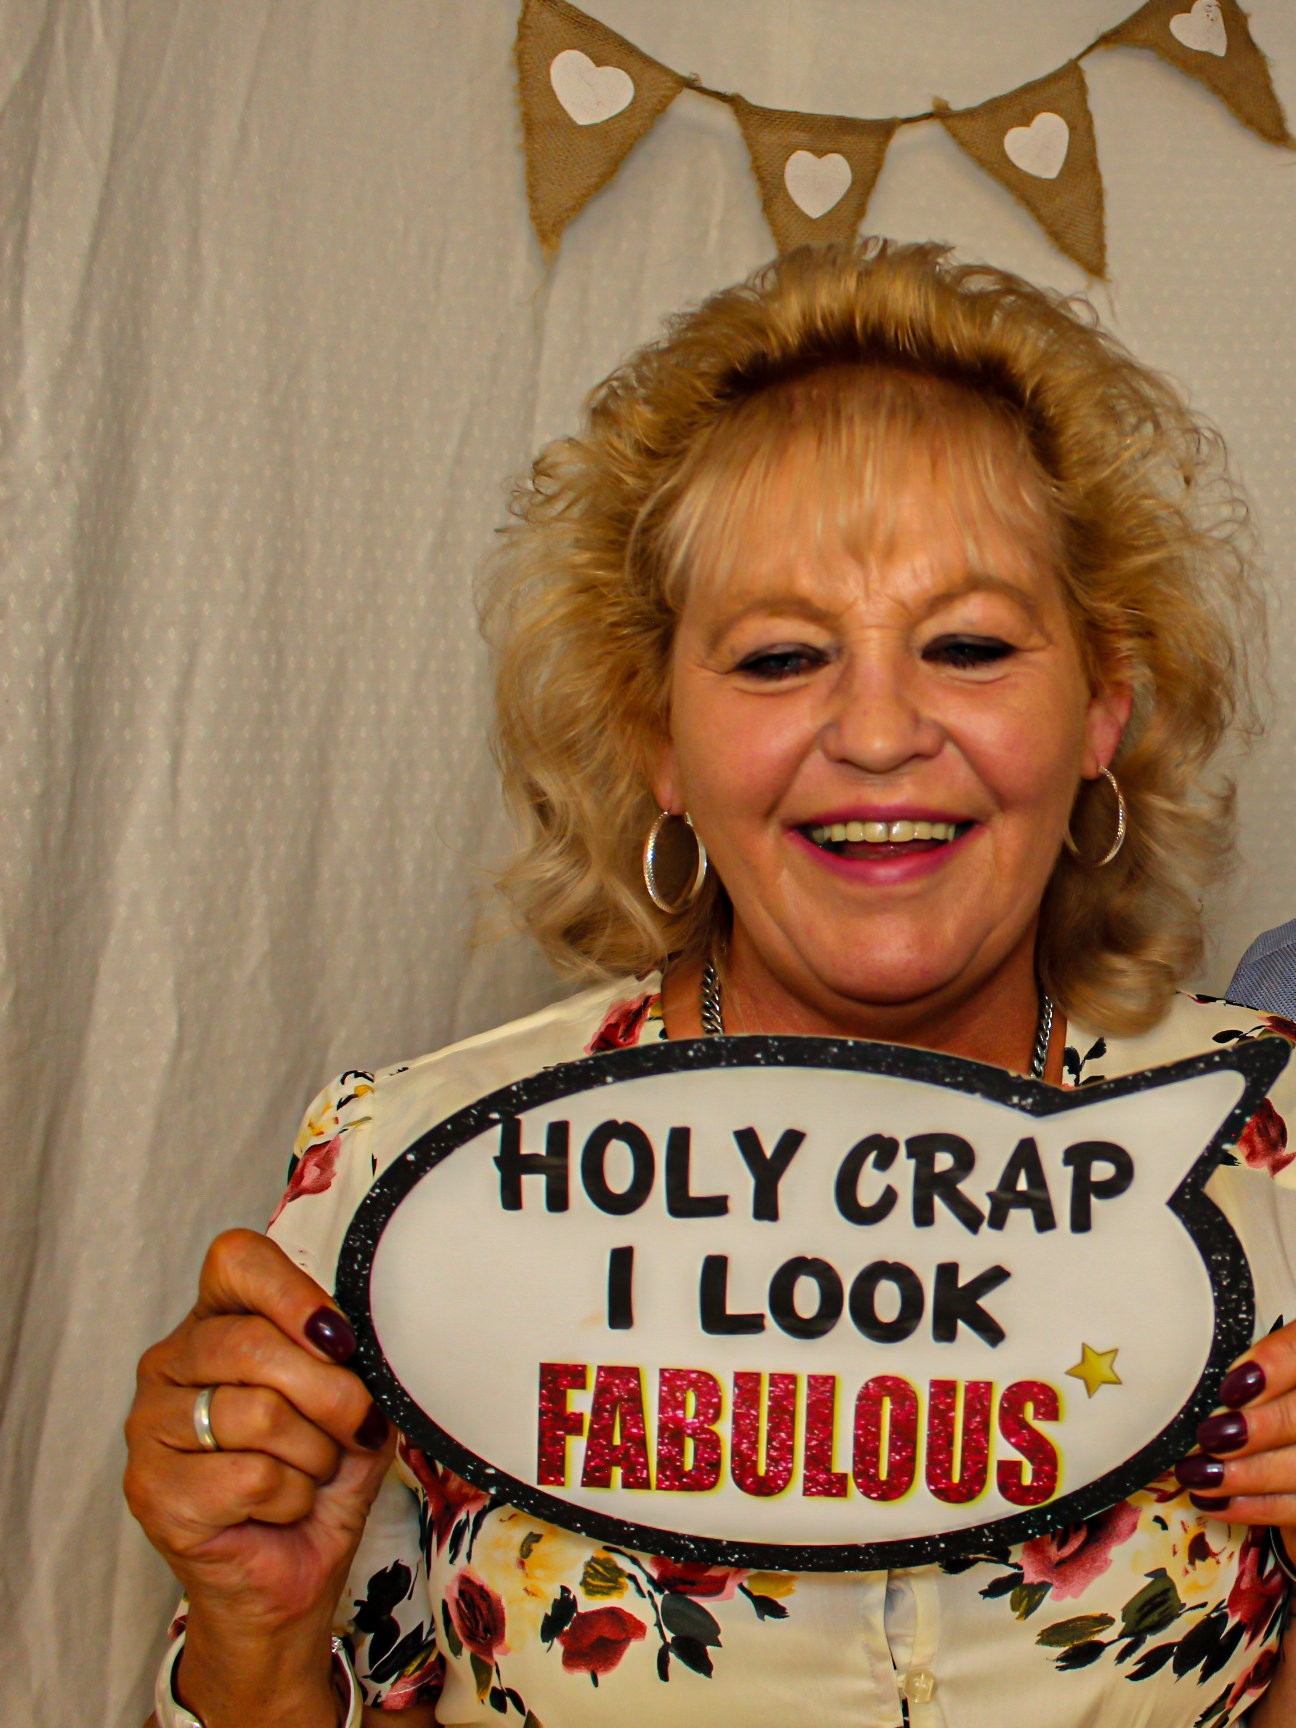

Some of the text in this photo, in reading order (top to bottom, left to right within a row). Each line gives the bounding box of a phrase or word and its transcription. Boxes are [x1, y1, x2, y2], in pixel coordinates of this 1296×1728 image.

[493, 1116, 1135, 1235] HOLY CRAP
[607, 1246, 1012, 1348] I LOOK
[536, 1362, 1061, 1506] FABULOUS
